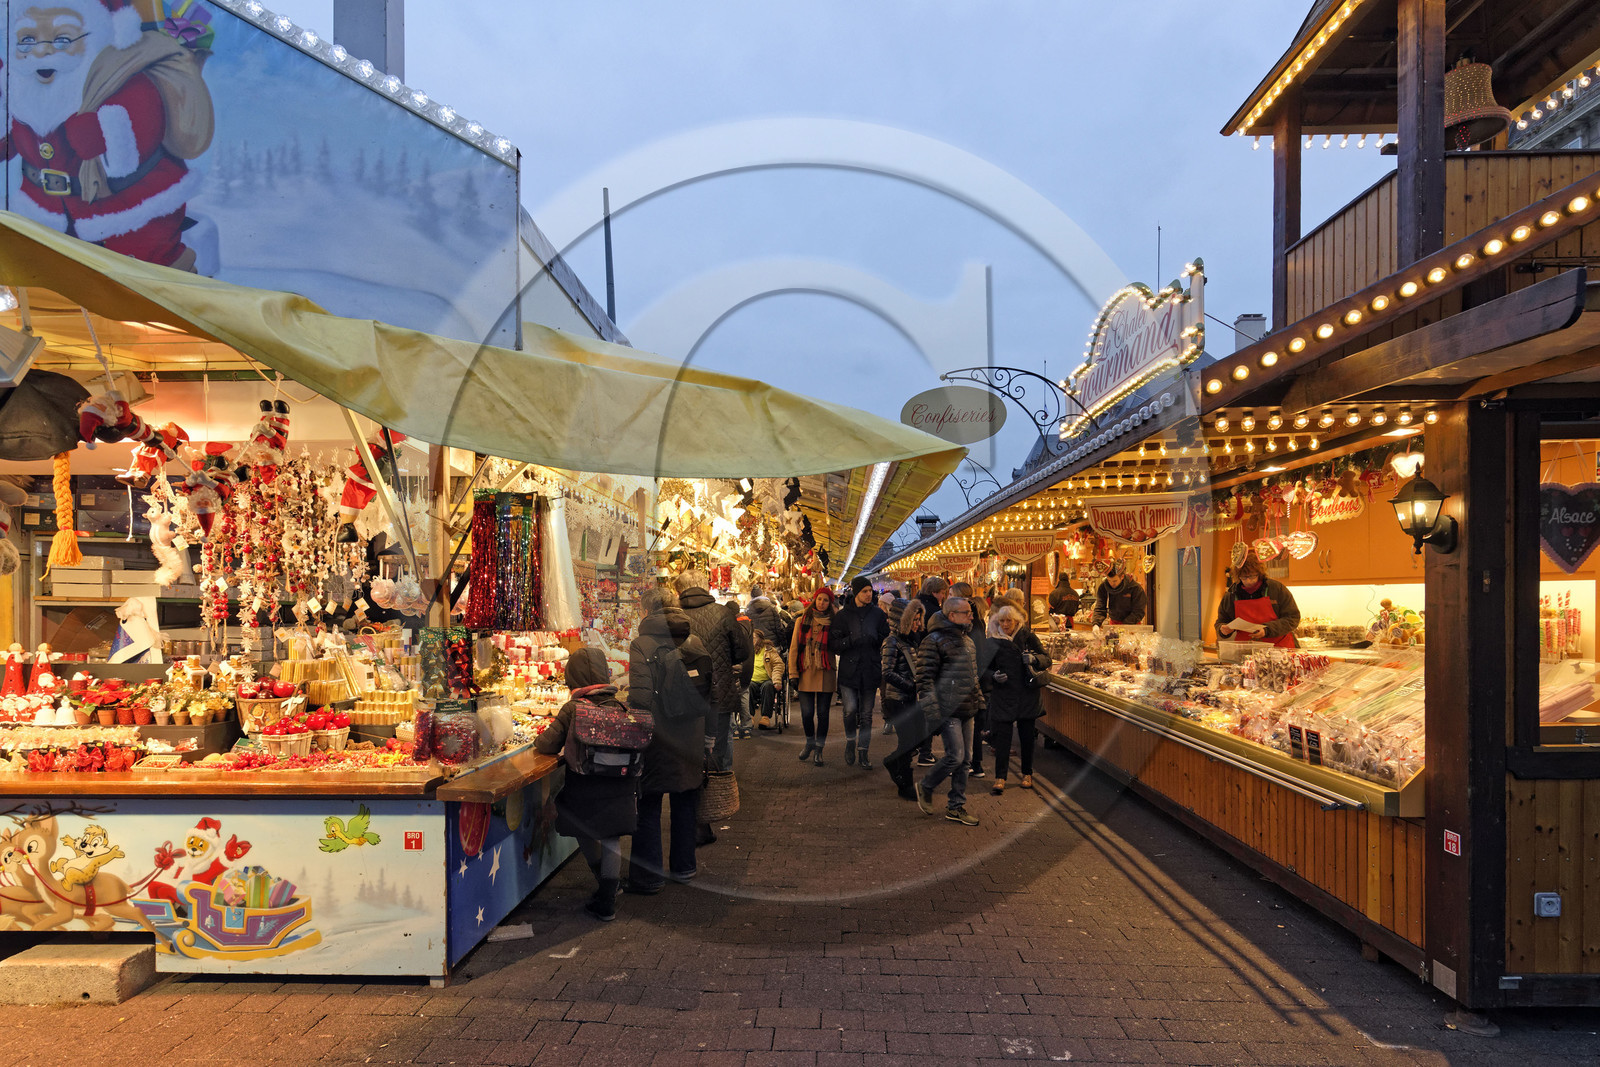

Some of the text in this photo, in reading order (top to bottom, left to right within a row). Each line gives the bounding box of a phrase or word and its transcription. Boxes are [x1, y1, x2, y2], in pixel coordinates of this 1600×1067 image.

[911, 404, 997, 433] Confiseries
[1310, 497, 1360, 518] Bonbons
[1548, 507, 1596, 524] Alsace
[1091, 506, 1183, 530] Pommes d'amour
[999, 542, 1051, 555] Boules Mousse
[410, 840, 415, 849] 1
[1448, 841, 1457, 852] 18
